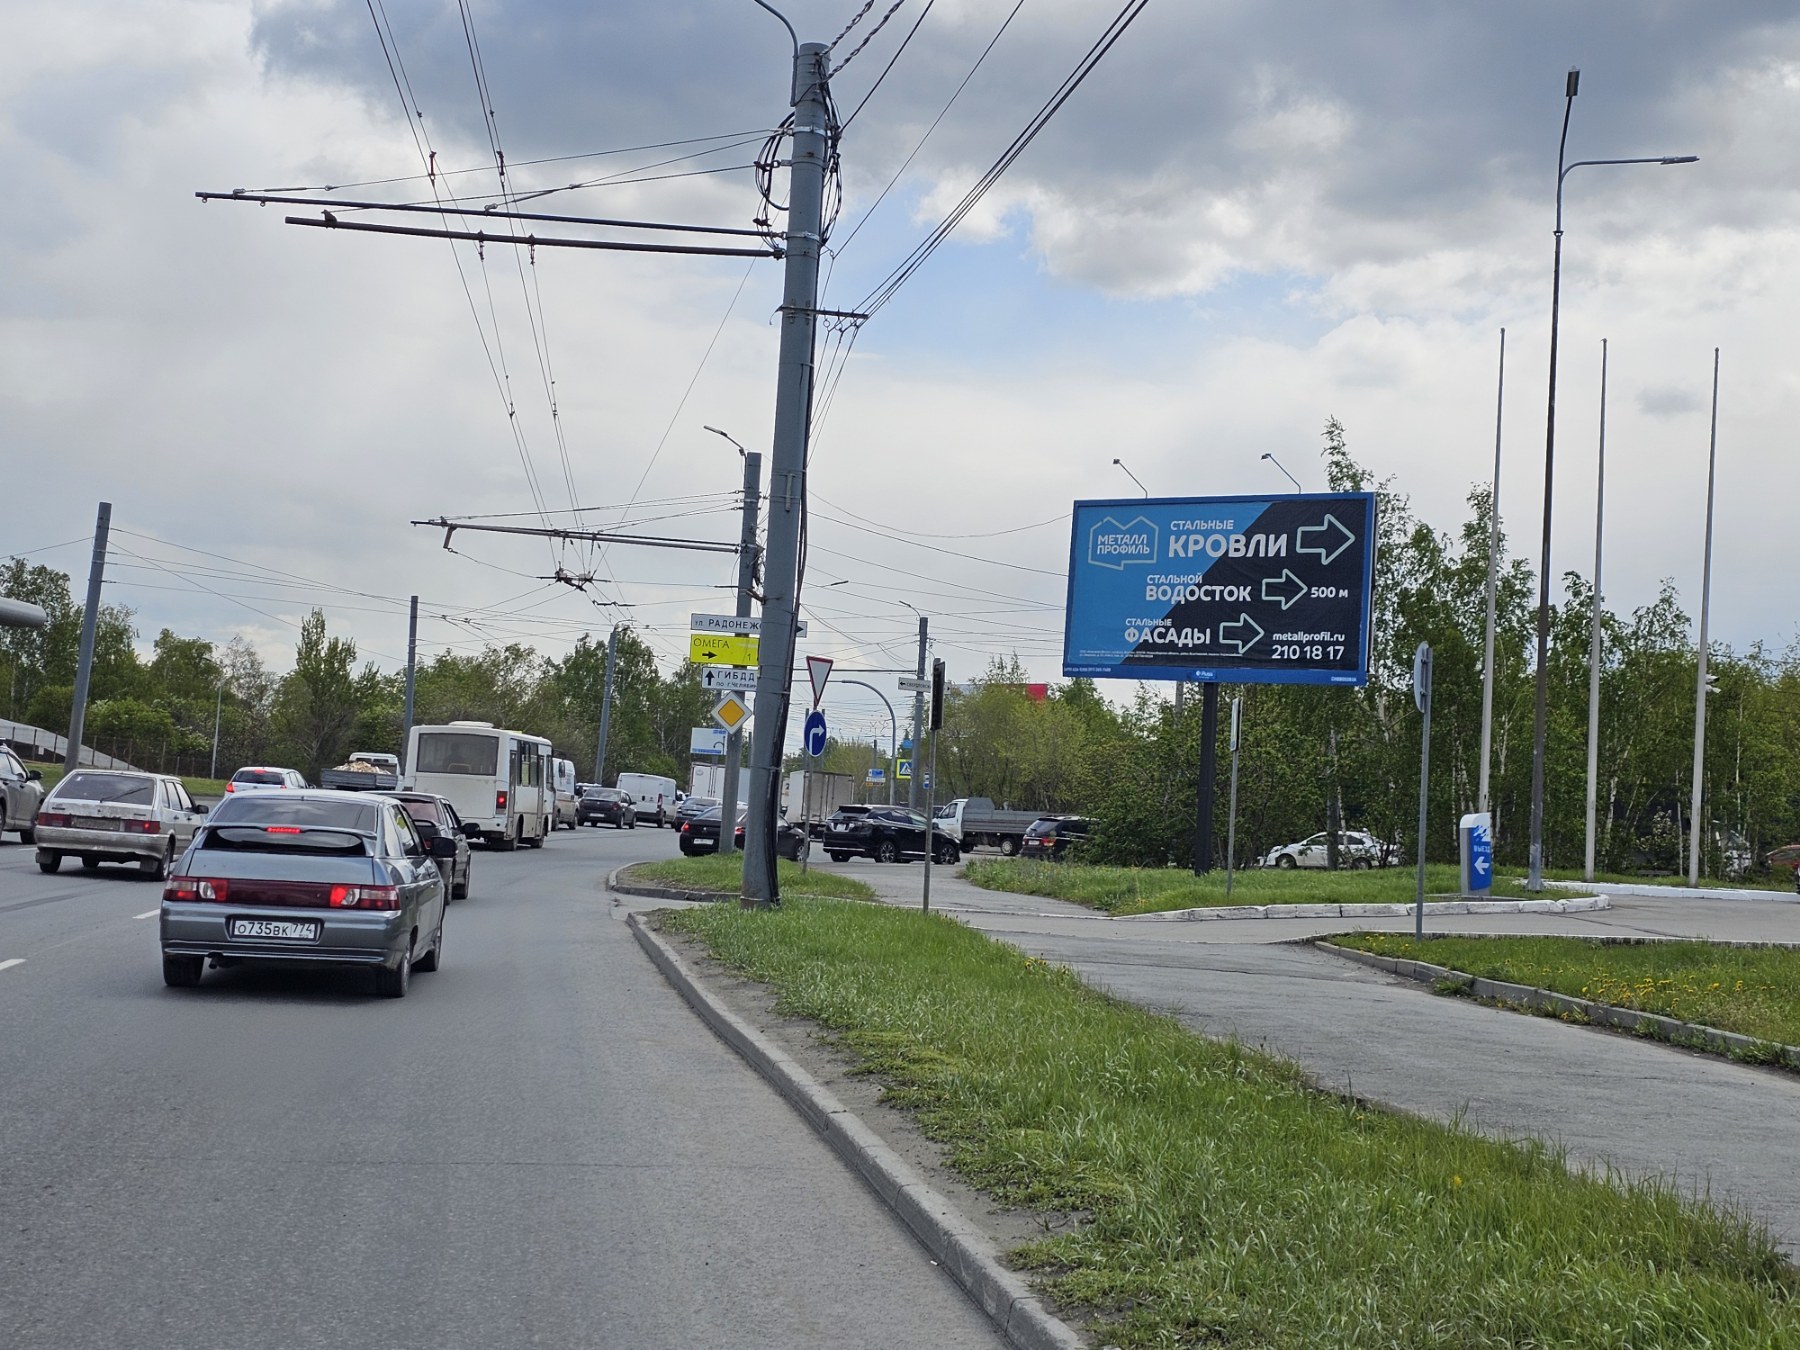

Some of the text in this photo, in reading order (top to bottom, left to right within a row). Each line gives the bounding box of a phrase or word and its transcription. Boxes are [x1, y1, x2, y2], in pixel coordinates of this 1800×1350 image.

[1170, 520, 1234, 531] СТАЛЬНЫЕ
[1097, 534, 1147, 545] МЕТАЛЛ
[1168, 533, 1288, 558] КРОВЛИ
[1096, 544, 1150, 555] ПРОФИЛЬ
[1146, 572, 1203, 584] СТАЛЬНОЙ
[1145, 585, 1252, 605] ВОДОСТОК
[1310, 586, 1336, 598] 500
[1125, 618, 1173, 626] СТАЛЬНЫЕ
[693, 637, 730, 649] ОМЕГА
[1124, 627, 1211, 648] ФАСАДЫ
[1272, 631, 1346, 643] metallprofil.ru
[1271, 645, 1345, 660] 210 18 17
[717, 670, 755, 682] ГИБДД
[292, 923, 312, 934] 774
